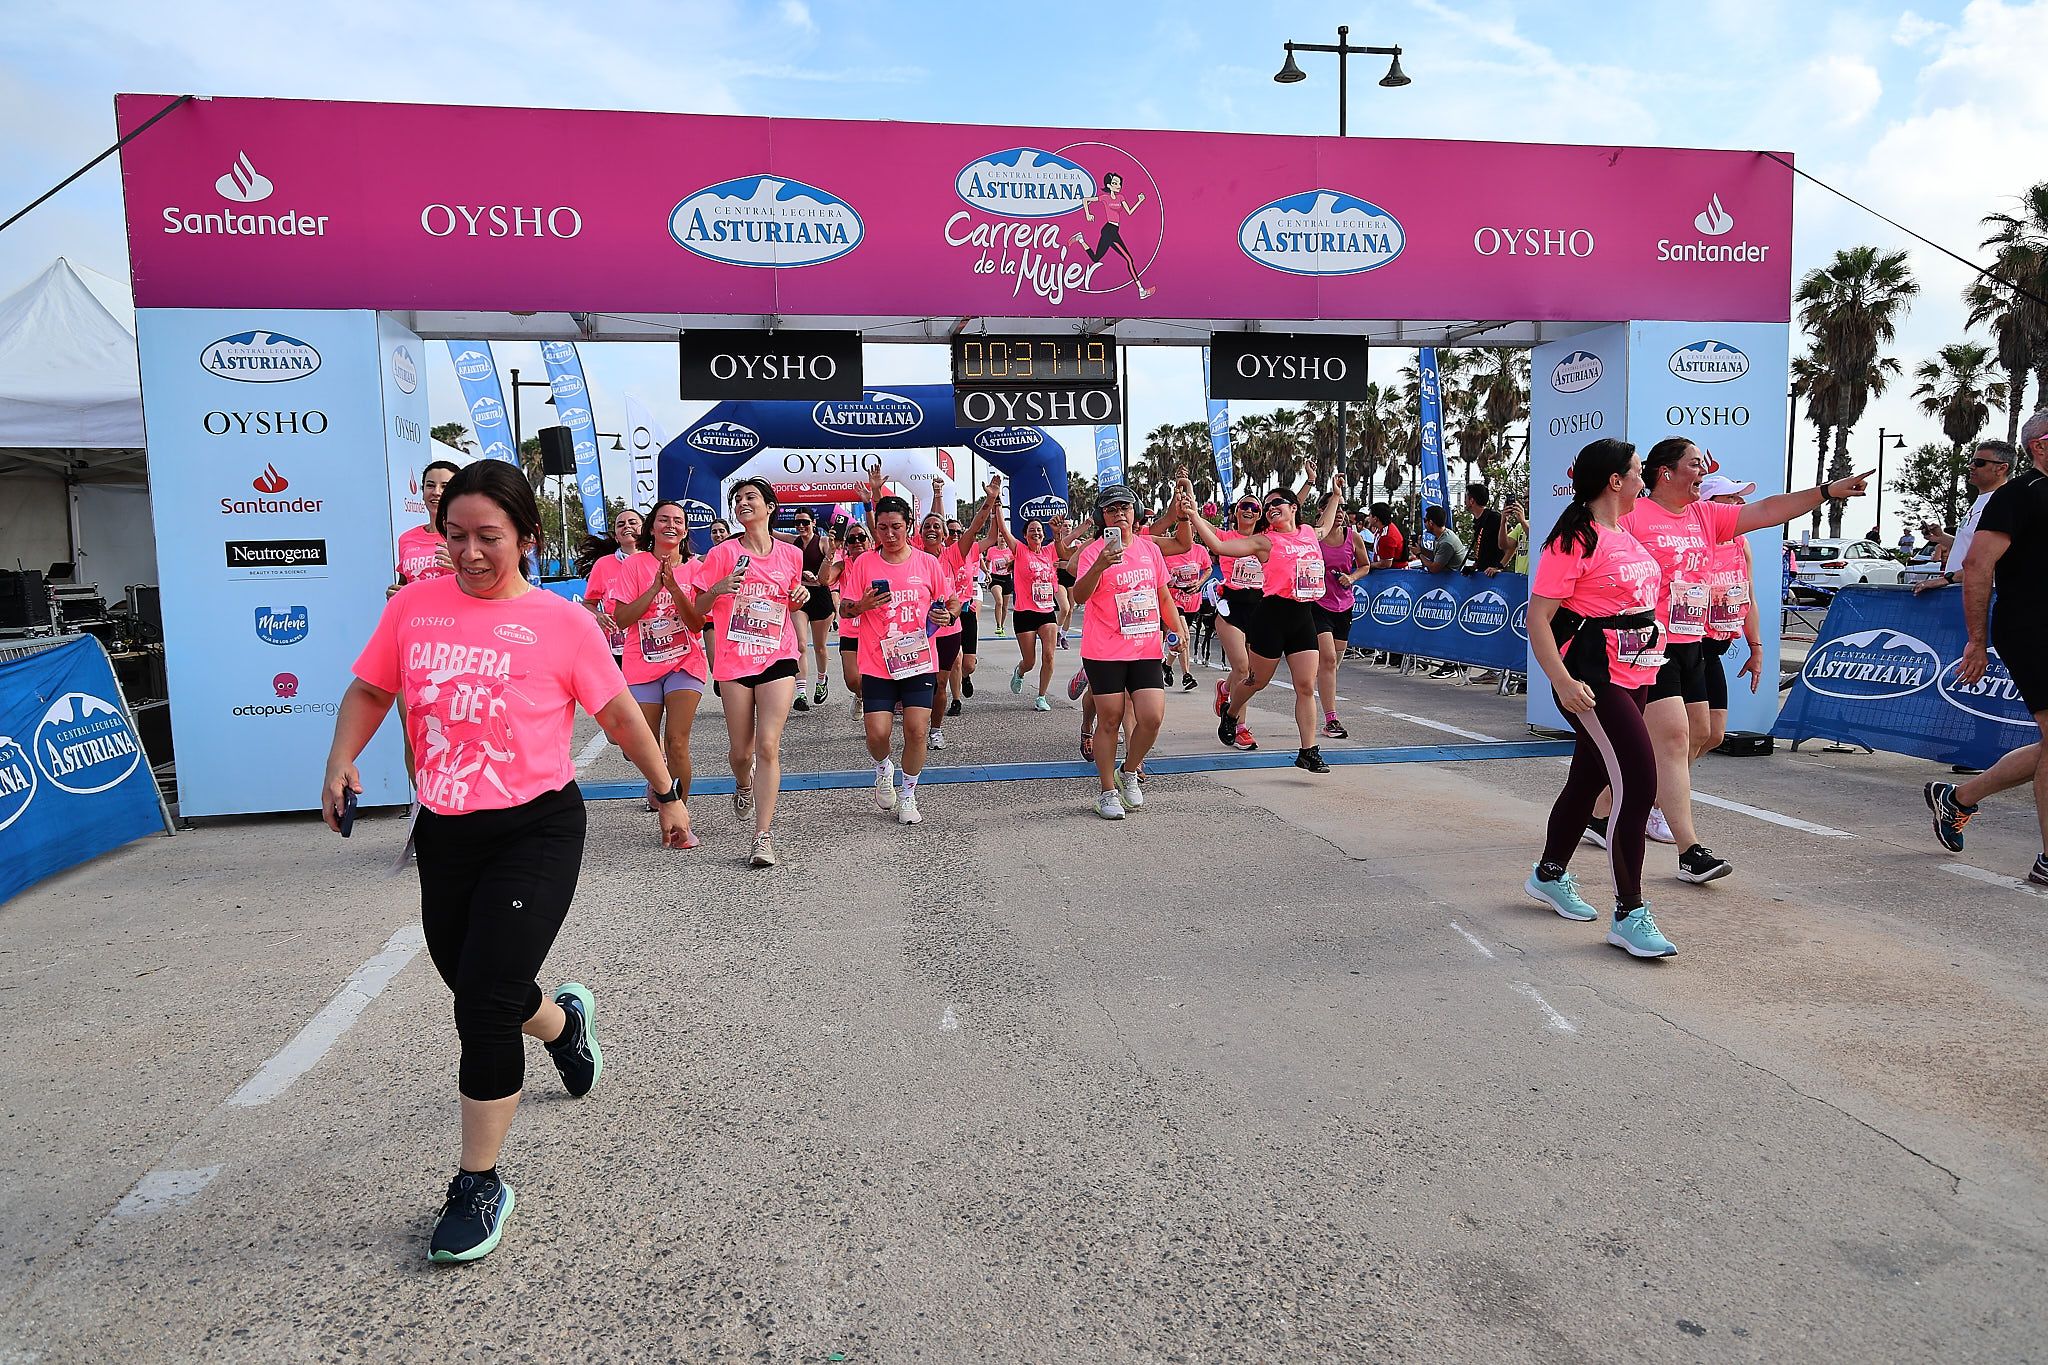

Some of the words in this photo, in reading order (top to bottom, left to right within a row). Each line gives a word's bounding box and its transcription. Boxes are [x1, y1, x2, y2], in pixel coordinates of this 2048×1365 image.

[967, 171, 1085, 200] ASTURIANA
[988, 170, 1033, 179] CENTRAL
[1036, 172, 1082, 180] LECHERA
[163, 206, 329, 237] Santander
[420, 203, 583, 239] OYSHO
[714, 206, 776, 217] CENTRAL
[781, 208, 843, 219] LECHERA
[685, 206, 850, 246] ASTURIANA
[944, 210, 1060, 248] Carrera
[1276, 218, 1330, 228] CENTRAL
[1335, 220, 1388, 230] LECHERA
[1251, 220, 1393, 255] ASTURIANA
[1473, 227, 1594, 258] OYSHO
[1657, 239, 1769, 263] Santander
[974, 250, 995, 274] de
[1000, 249, 1016, 275] la
[1013, 246, 1104, 305] Mujer
[210, 350, 313, 370] ASTURIANA
[709, 353, 837, 381] OYSHO
[964, 342, 1106, 377] 00:37:19
[1236, 353, 1347, 381] OYSHO
[1674, 355, 1744, 372] ASTURIANA
[1554, 366, 1599, 387] ASTURIANA
[821, 404, 916, 425] ASTURIANA
[963, 390, 1113, 422] OYSHO
[1666, 405, 1750, 426] OYSHO
[204, 410, 328, 435] OYSHO
[395, 415, 421, 444] OYSHO
[1550, 410, 1604, 437] OYSHO
[692, 432, 754, 447] ASTURIANA
[980, 434, 1040, 448] ASTURIANA
[783, 453, 882, 474] OYSHO
[771, 483, 798, 493] Sports
[812, 482, 856, 491] Santander
[1552, 482, 1576, 497] Santa
[220, 496, 324, 515] Santander
[404, 497, 426, 514] Santande
[688, 513, 714, 523] RIANA
[1657, 535, 1707, 549] CARRERA
[232, 545, 321, 564] Neutrogena
[1133, 609, 1149, 618] 016
[1373, 599, 1408, 616] ASTURIANA
[1414, 601, 1453, 621] ASTURIANA
[1460, 605, 1504, 625] ASTURIANA
[1688, 606, 1703, 616] 016
[1727, 605, 1741, 614] 016
[259, 614, 306, 635] Marlene
[410, 615, 456, 628] OYSHO
[747, 618, 768, 629] 016
[655, 634, 674, 646] 016
[408, 641, 512, 681] CARRERA
[900, 654, 920, 668] 016
[1834, 650, 1878, 661] CENTRAL
[1880, 654, 1929, 665] LECHERA
[1807, 651, 1924, 687] ASTURIANA
[449, 683, 483, 725] DE
[57, 724, 90, 742] CENTRAL
[92, 717, 123, 733] LECHERA
[46, 728, 137, 778] ASTURIANA
